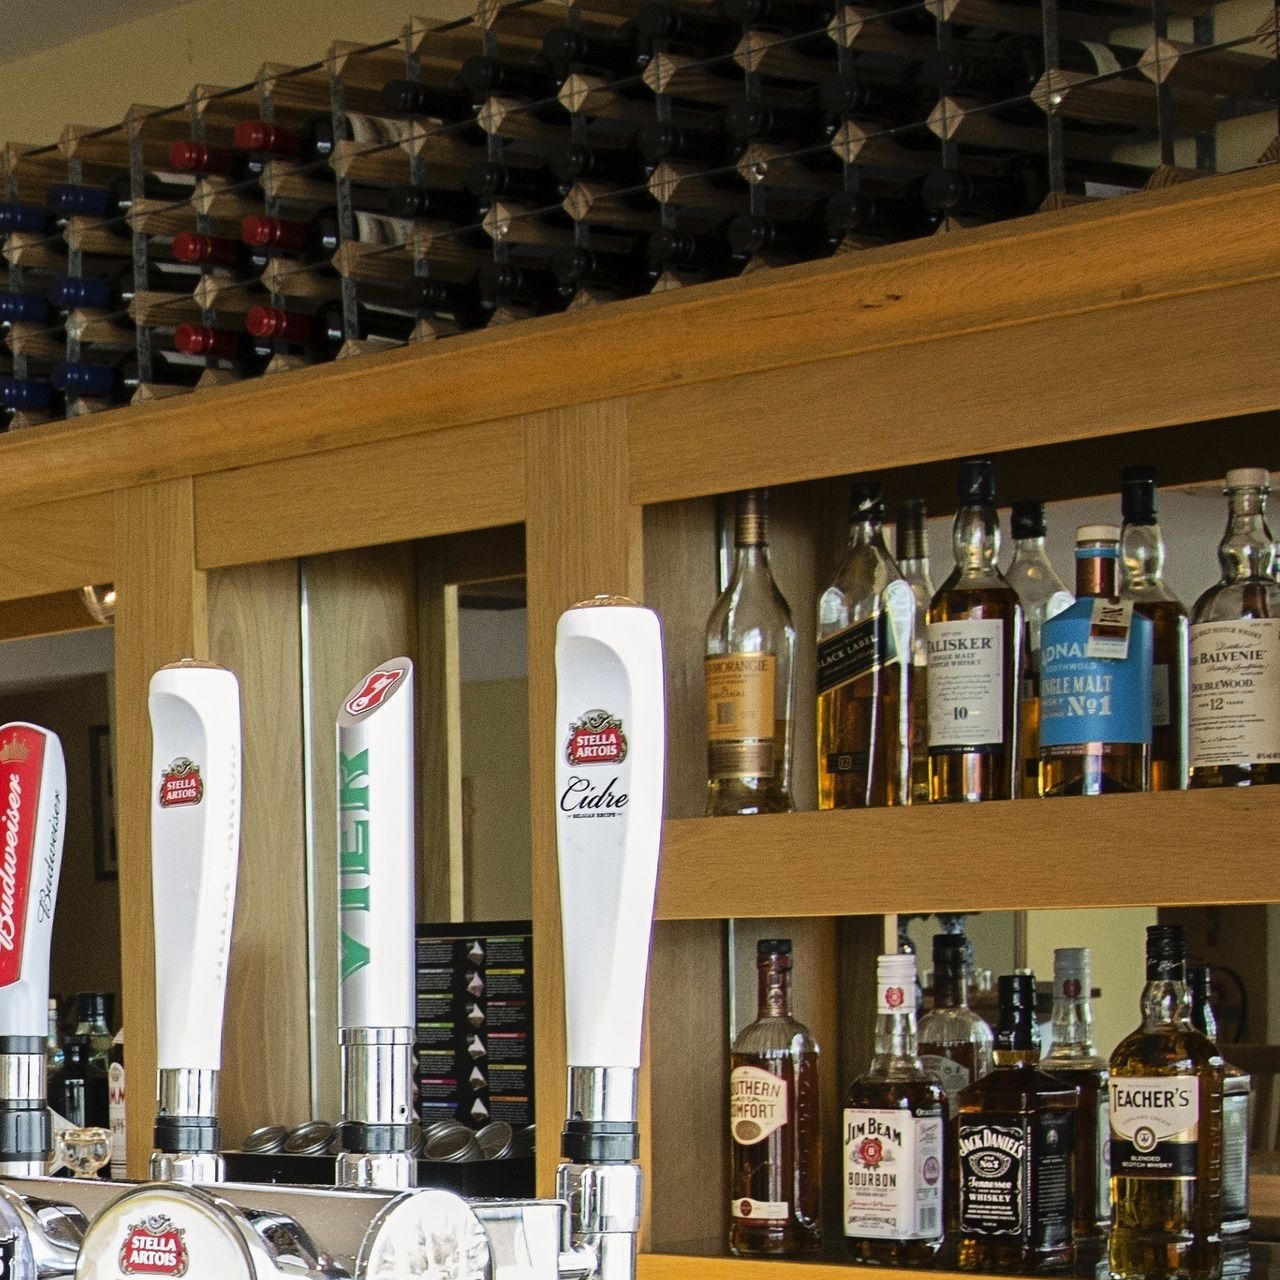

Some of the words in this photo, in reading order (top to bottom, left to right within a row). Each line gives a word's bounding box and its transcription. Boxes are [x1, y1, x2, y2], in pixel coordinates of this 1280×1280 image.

[820, 652, 844, 669] LACK
[1200, 650, 1264, 664] BALVENIE
[1073, 675, 1113, 693] MALT
[1210, 697, 1223, 710] 12
[953, 706, 969, 721] 10
[577, 734, 618, 746] STELLA
[576, 745, 618, 758] ARTOIS
[167, 779, 197, 790] STELLA
[166, 788, 197, 801] ARTOIS
[560, 776, 629, 812] Cidre
[38, 789, 62, 923] Budweiser
[337, 749, 371, 981] VIER
[1112, 1084, 1190, 1113] TEACHER'S
[731, 1103, 777, 1119] OMFORT
[845, 1121, 865, 1145] JIM
[867, 1116, 902, 1147] BEAM
[959, 1133, 983, 1157] JACK
[983, 1128, 1027, 1160] DANIEL'S
[848, 1172, 897, 1187] BOURBON
[968, 1193, 1012, 1203] WHISKEY
[132, 1235, 177, 1252] STELLA
[130, 1250, 177, 1267] ARTOIS
